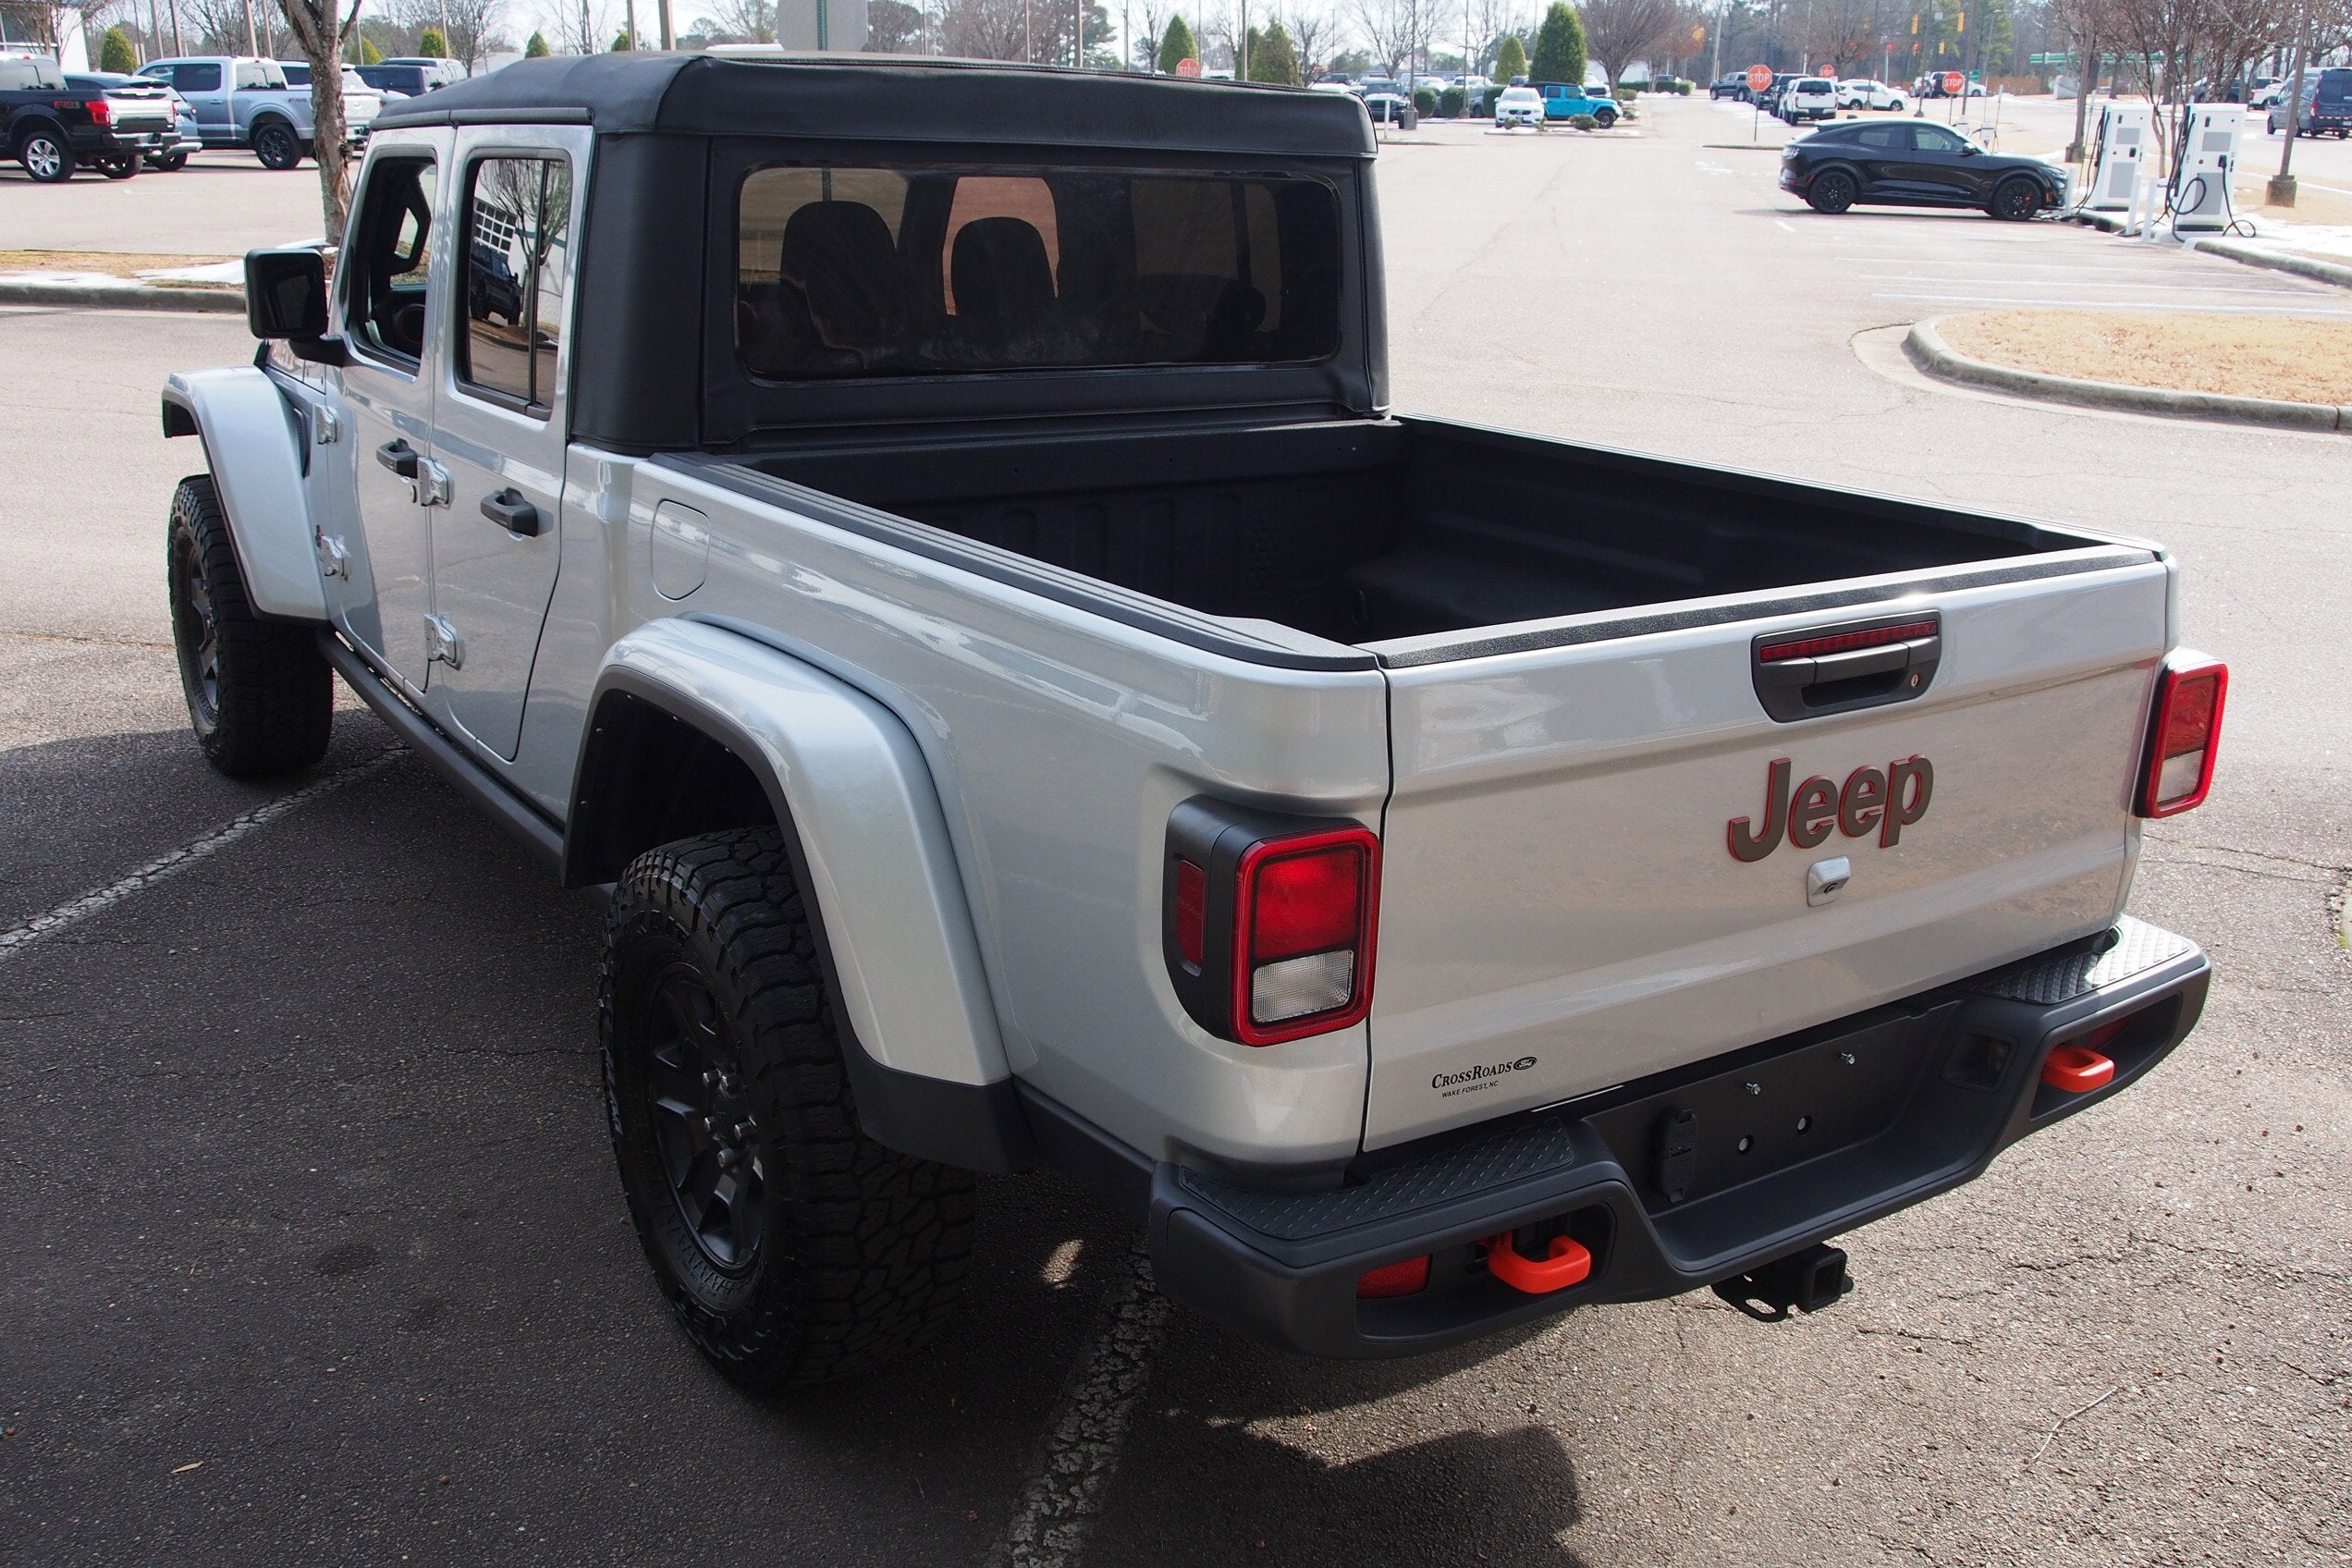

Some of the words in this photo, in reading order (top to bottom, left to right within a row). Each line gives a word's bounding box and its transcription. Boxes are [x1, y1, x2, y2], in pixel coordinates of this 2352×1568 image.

[1179, 67, 1198, 77] STOP
[1748, 73, 1770, 83] STOP
[1944, 79, 1963, 87] STOP
[1727, 753, 1934, 863] Jeep
[1441, 1089, 1461, 1098] WAKE
[1462, 1083, 1489, 1094] FOREST,
